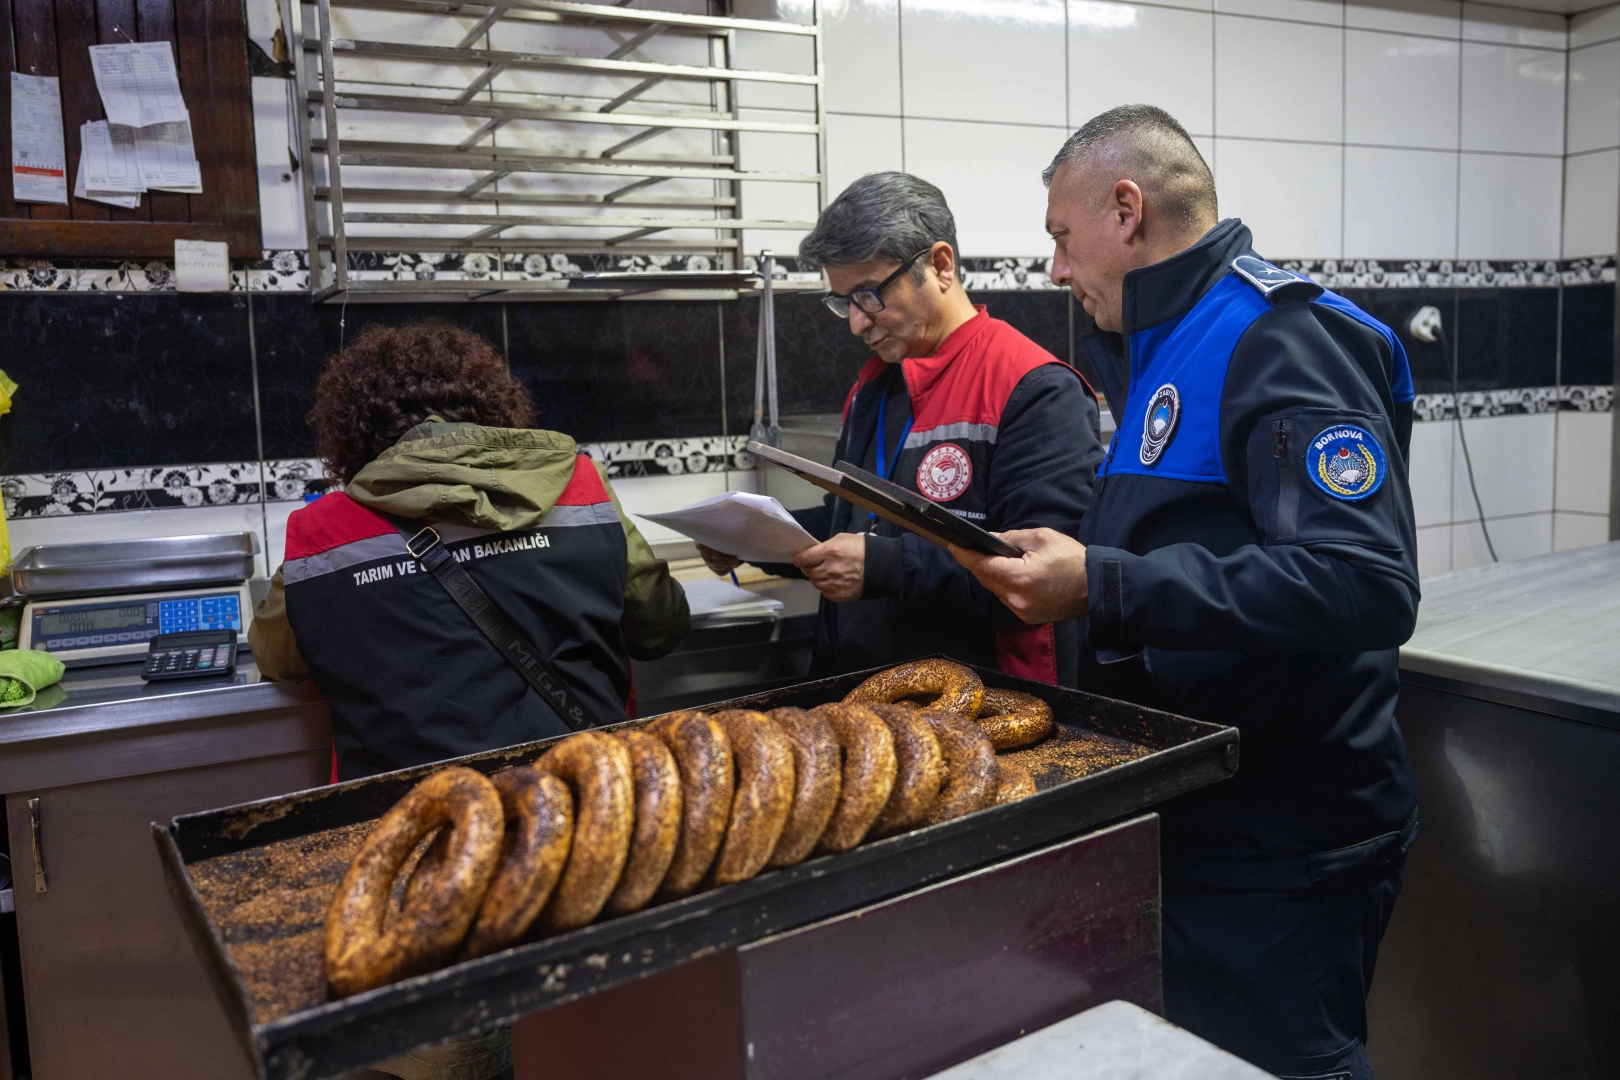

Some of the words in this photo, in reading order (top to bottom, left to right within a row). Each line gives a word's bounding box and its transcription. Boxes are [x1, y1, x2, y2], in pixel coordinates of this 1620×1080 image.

[1314, 429, 1363, 450] BORNOVA
[353, 564, 394, 586] TARIM
[398, 561, 417, 576] VE
[474, 533, 551, 559] BAKANLIĞI
[507, 639, 567, 709] MEGA
[568, 706, 584, 725] &
